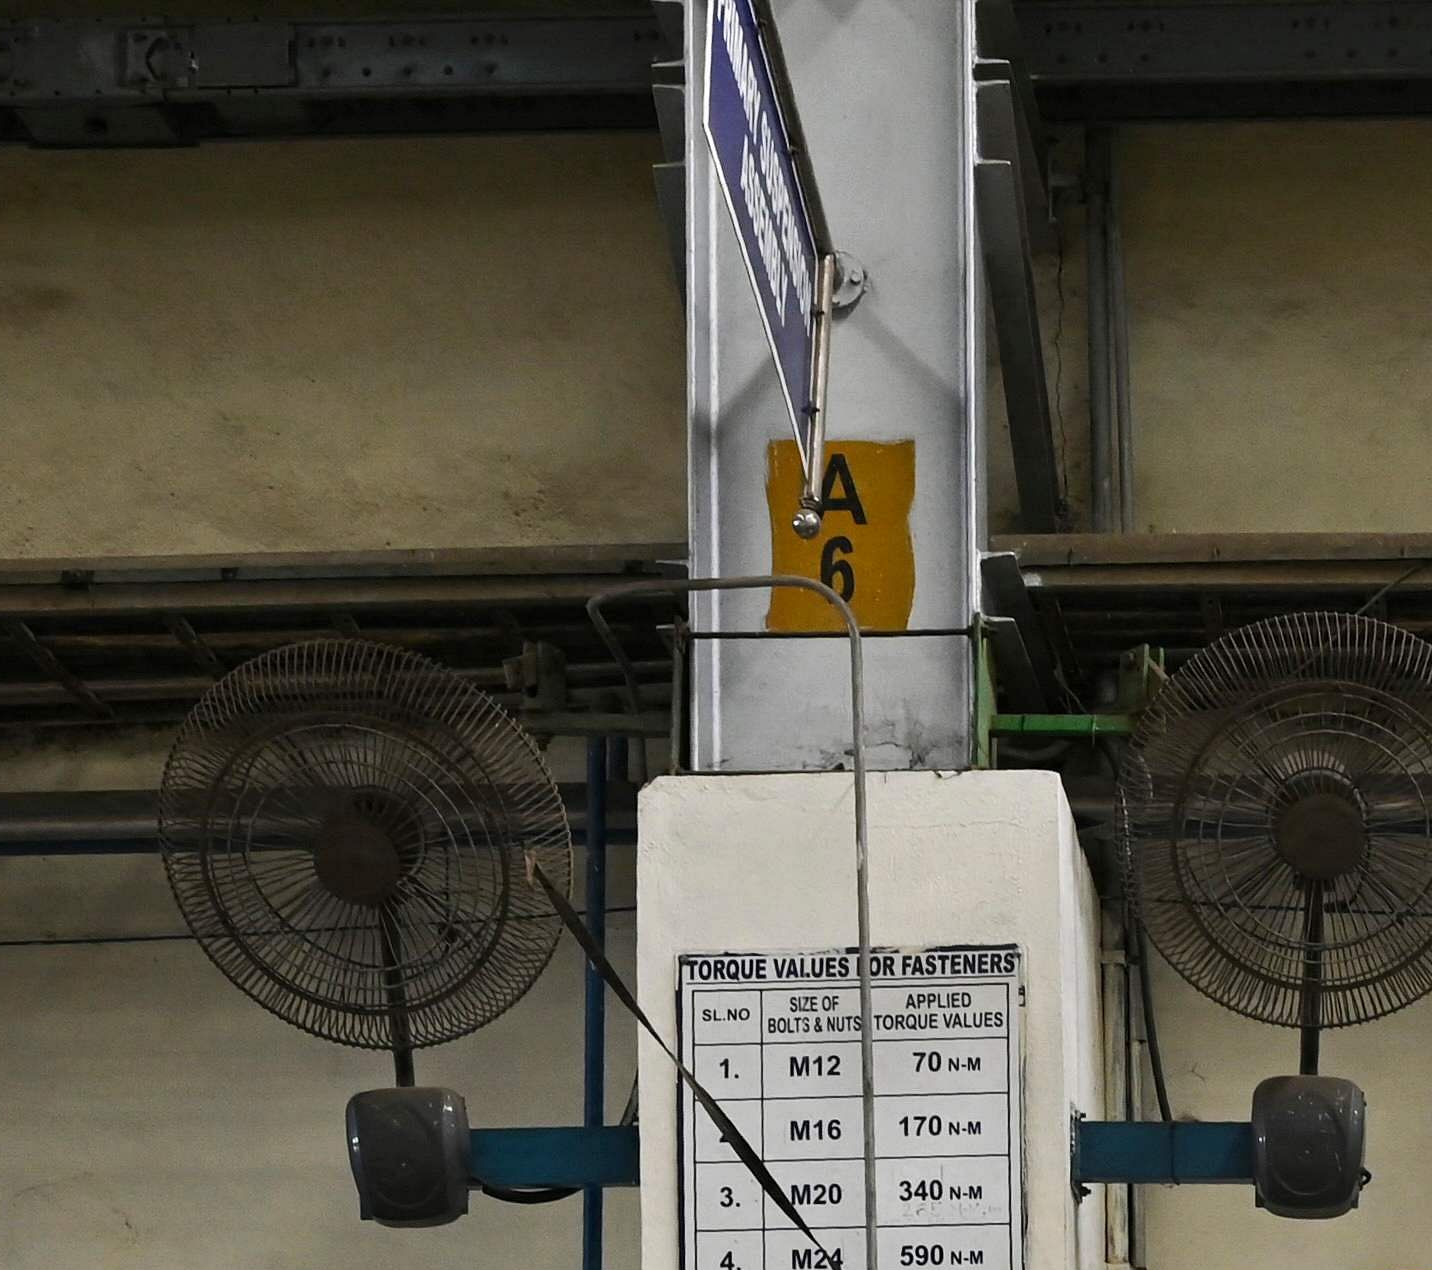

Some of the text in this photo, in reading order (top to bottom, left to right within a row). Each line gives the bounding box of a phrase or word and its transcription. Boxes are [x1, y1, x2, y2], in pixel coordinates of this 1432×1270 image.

[821, 454, 867, 525] A
[820, 536, 855, 605] 6
[688, 953, 1014, 981] TORQUE VALUES OR FASTENERS
[789, 996, 839, 1012] SIZE OF
[906, 993, 971, 1009] APPLIED
[702, 1008, 750, 1022] SL.NO
[768, 1015, 862, 1034] BOLTS & NUTS
[874, 1012, 1003, 1030] TORQUE VALUES
[720, 1059, 739, 1079] 1.
[789, 1056, 841, 1076] M12
[913, 1052, 981, 1072] 70 N-M
[790, 1120, 841, 1140] M16
[899, 1116, 981, 1136] 170 N-M
[720, 1187, 741, 1207] 3.
[791, 1184, 842, 1204] M20
[899, 1180, 982, 1201] 340 N-M
[720, 1251, 741, 1270] 4.
[900, 1244, 983, 1265] 590 N-M
